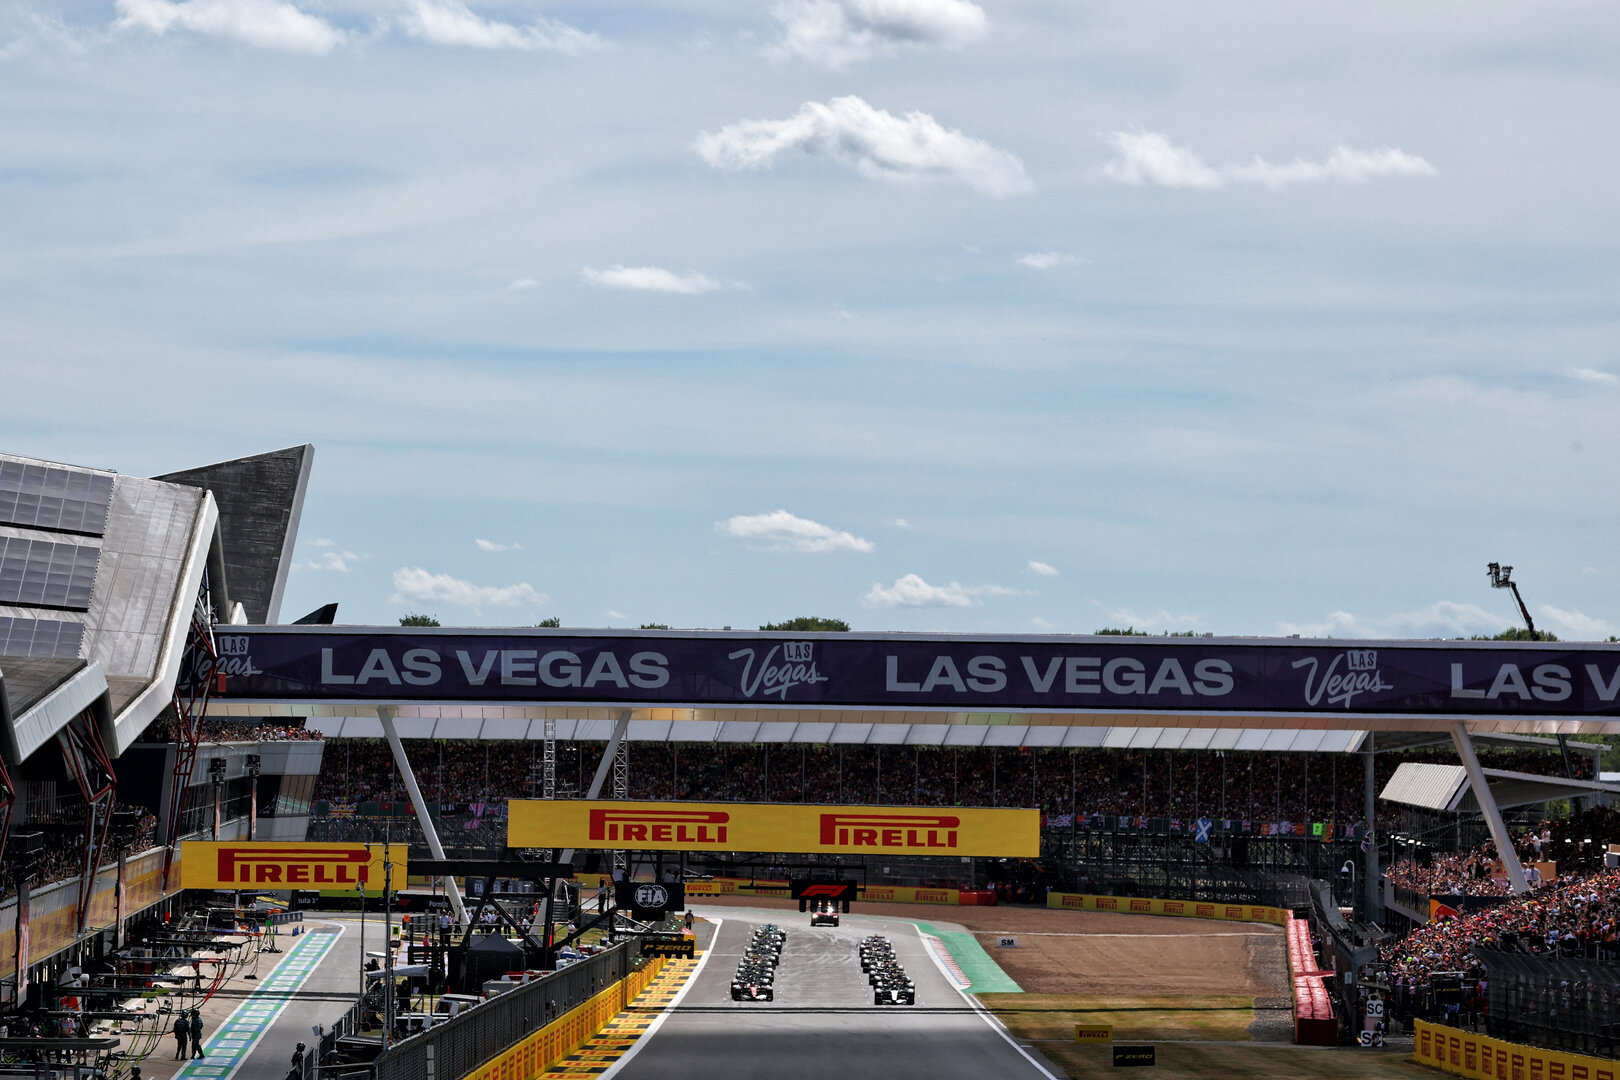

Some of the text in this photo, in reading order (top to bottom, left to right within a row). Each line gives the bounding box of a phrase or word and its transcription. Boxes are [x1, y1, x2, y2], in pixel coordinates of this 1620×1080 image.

[222, 638, 247, 653] LAS
[787, 644, 811, 660] LAS
[1350, 651, 1375, 669] LAS
[321, 648, 670, 689] LAS VEGAS
[729, 645, 829, 700] Vegas
[886, 655, 1235, 697] LAS VEGAS
[1292, 653, 1394, 709] Vegas
[1451, 663, 1572, 701] LAS
[589, 809, 730, 843] PIRELLI
[819, 814, 960, 848] PIRELLI
[218, 848, 372, 883] PIRELLI
[637, 889, 666, 904] FIA
[1367, 1003, 1383, 1014] SC
